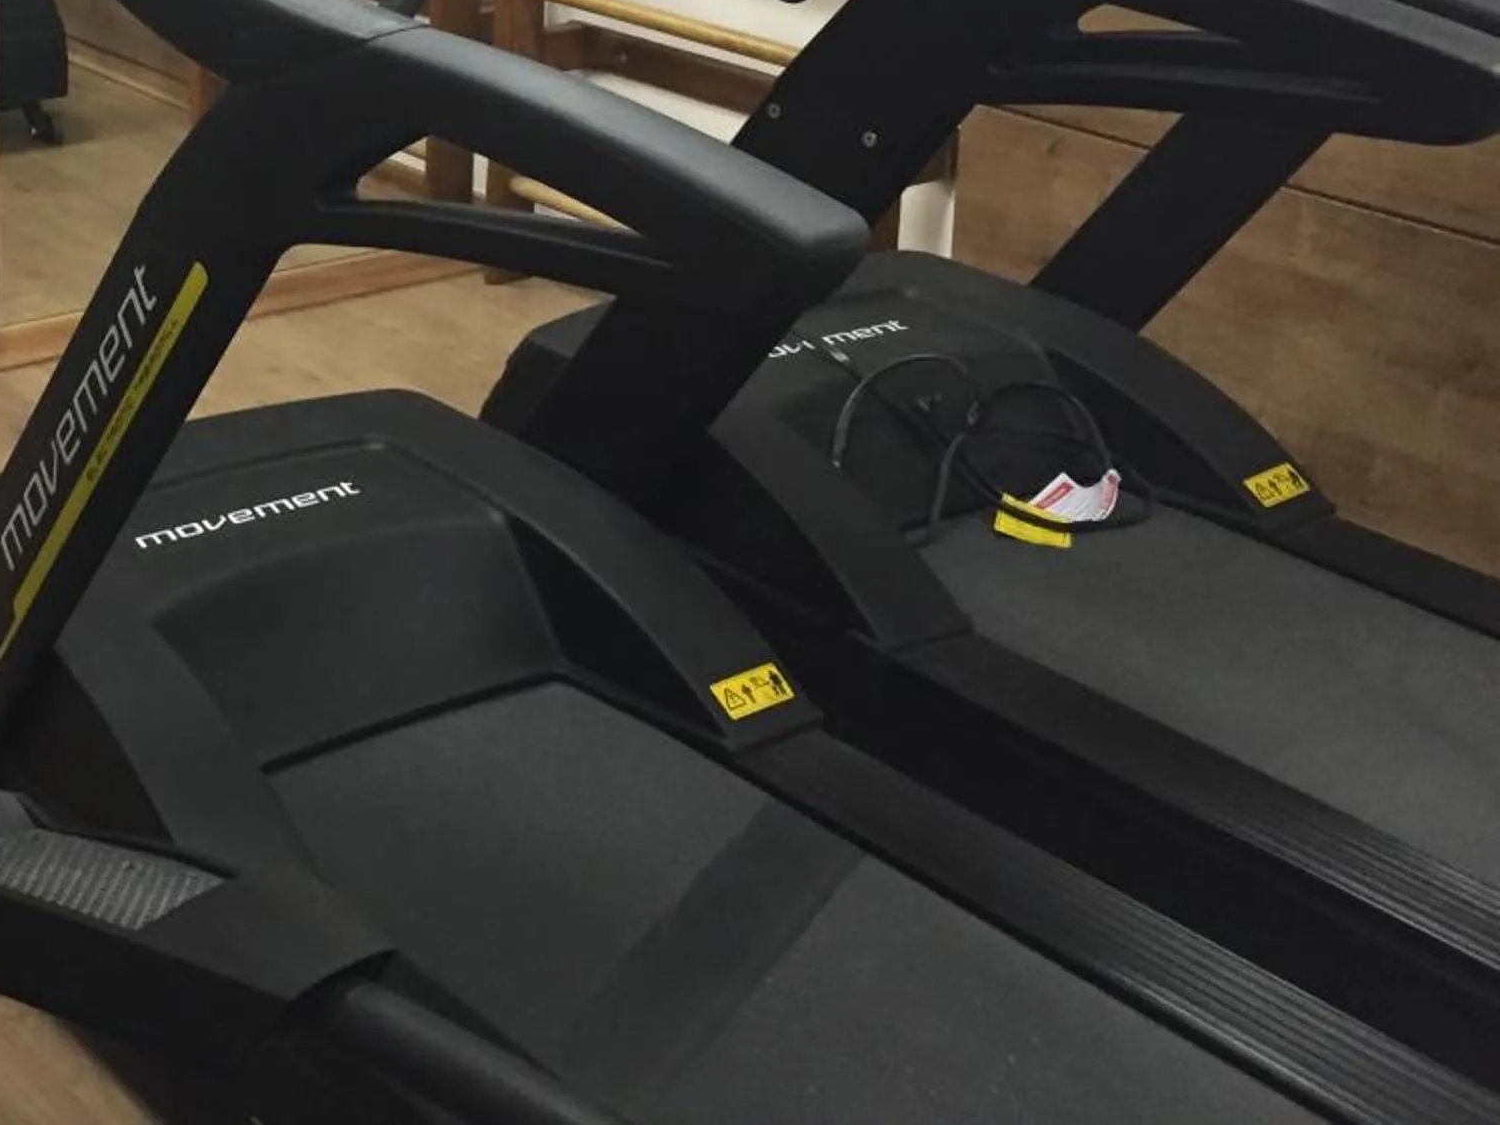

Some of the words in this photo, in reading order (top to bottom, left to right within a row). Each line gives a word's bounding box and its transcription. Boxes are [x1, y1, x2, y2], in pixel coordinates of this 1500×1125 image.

[768, 319, 910, 358] ovment
[0, 264, 158, 571] movement
[134, 481, 361, 549] movement
